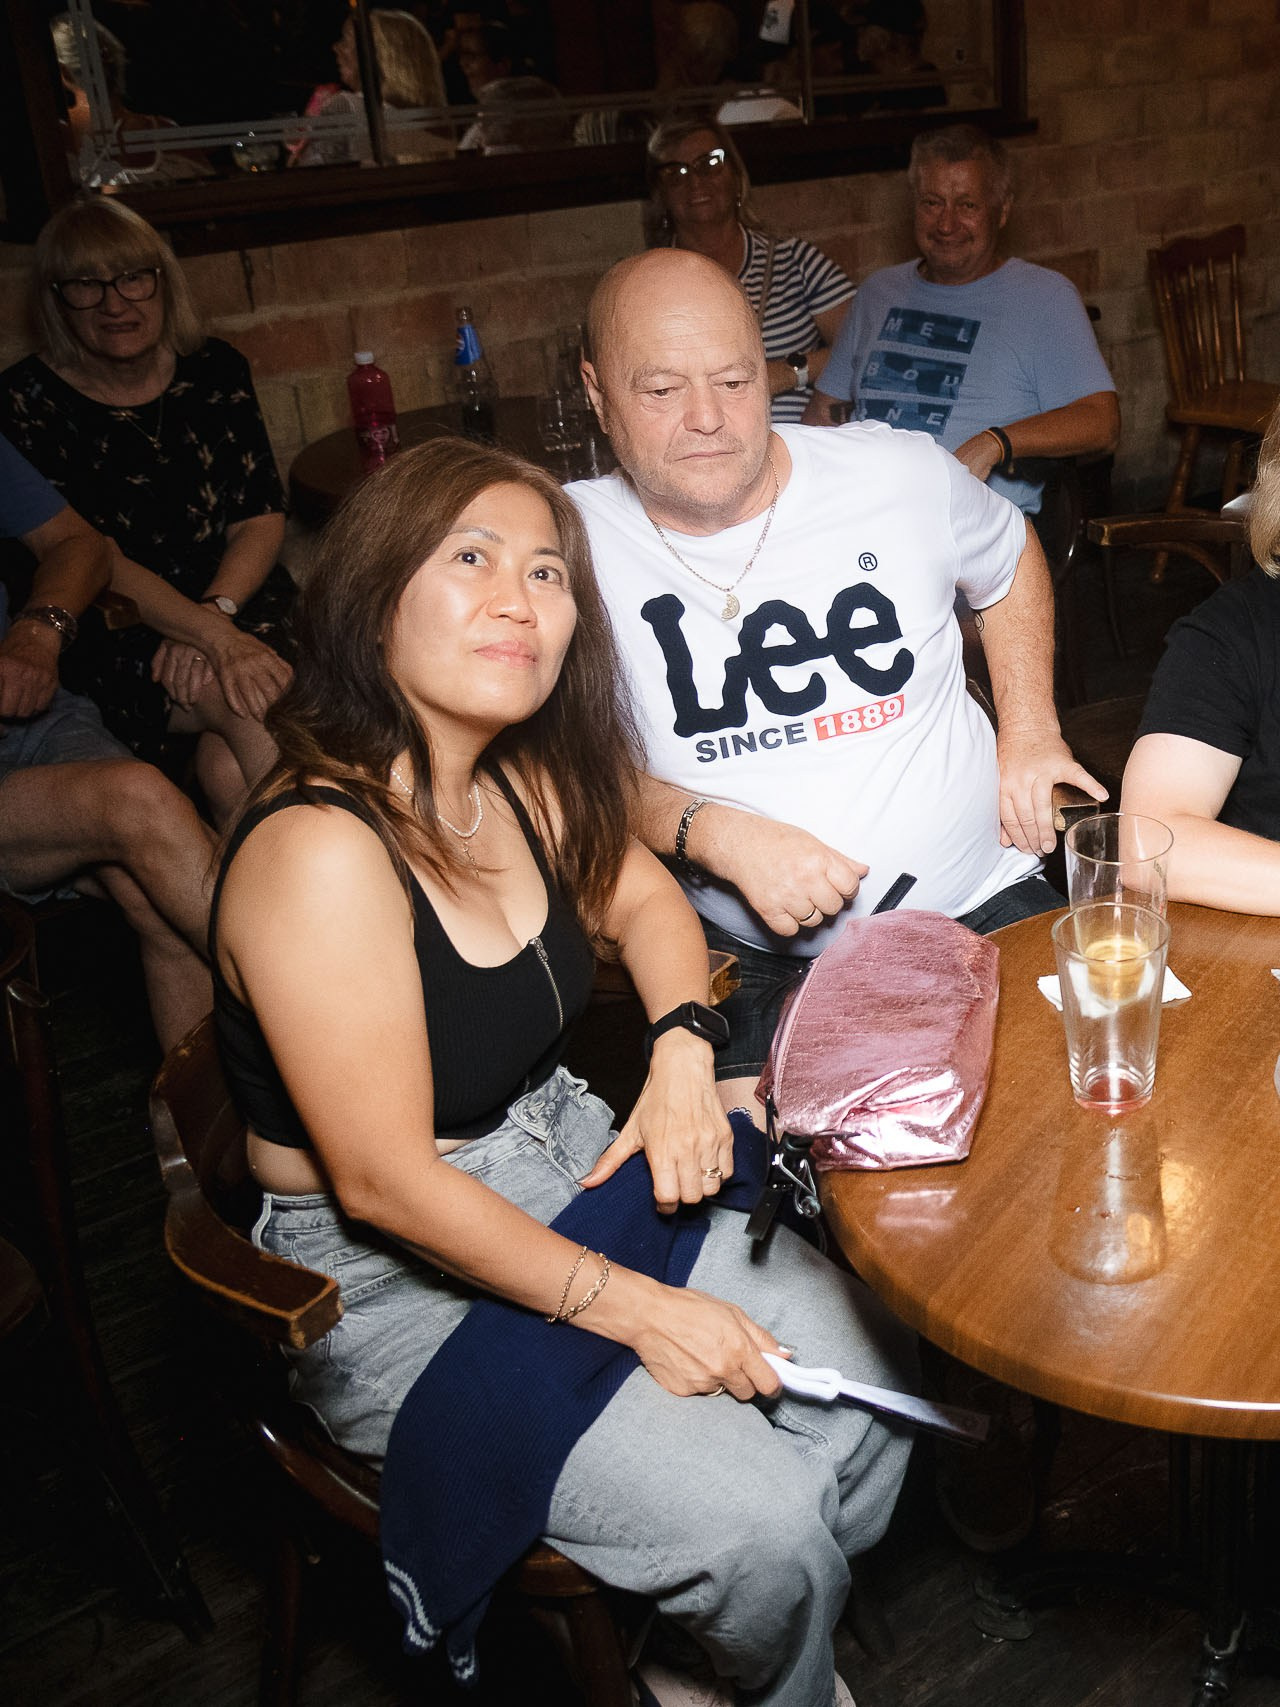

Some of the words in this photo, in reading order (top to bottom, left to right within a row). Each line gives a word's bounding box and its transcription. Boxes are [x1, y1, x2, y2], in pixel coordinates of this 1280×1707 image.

[885, 317, 969, 343] MEL
[867, 362, 959, 386] BOU
[640, 582, 914, 738] Lee
[695, 722, 807, 763] SINCE
[818, 697, 903, 738] 1889
